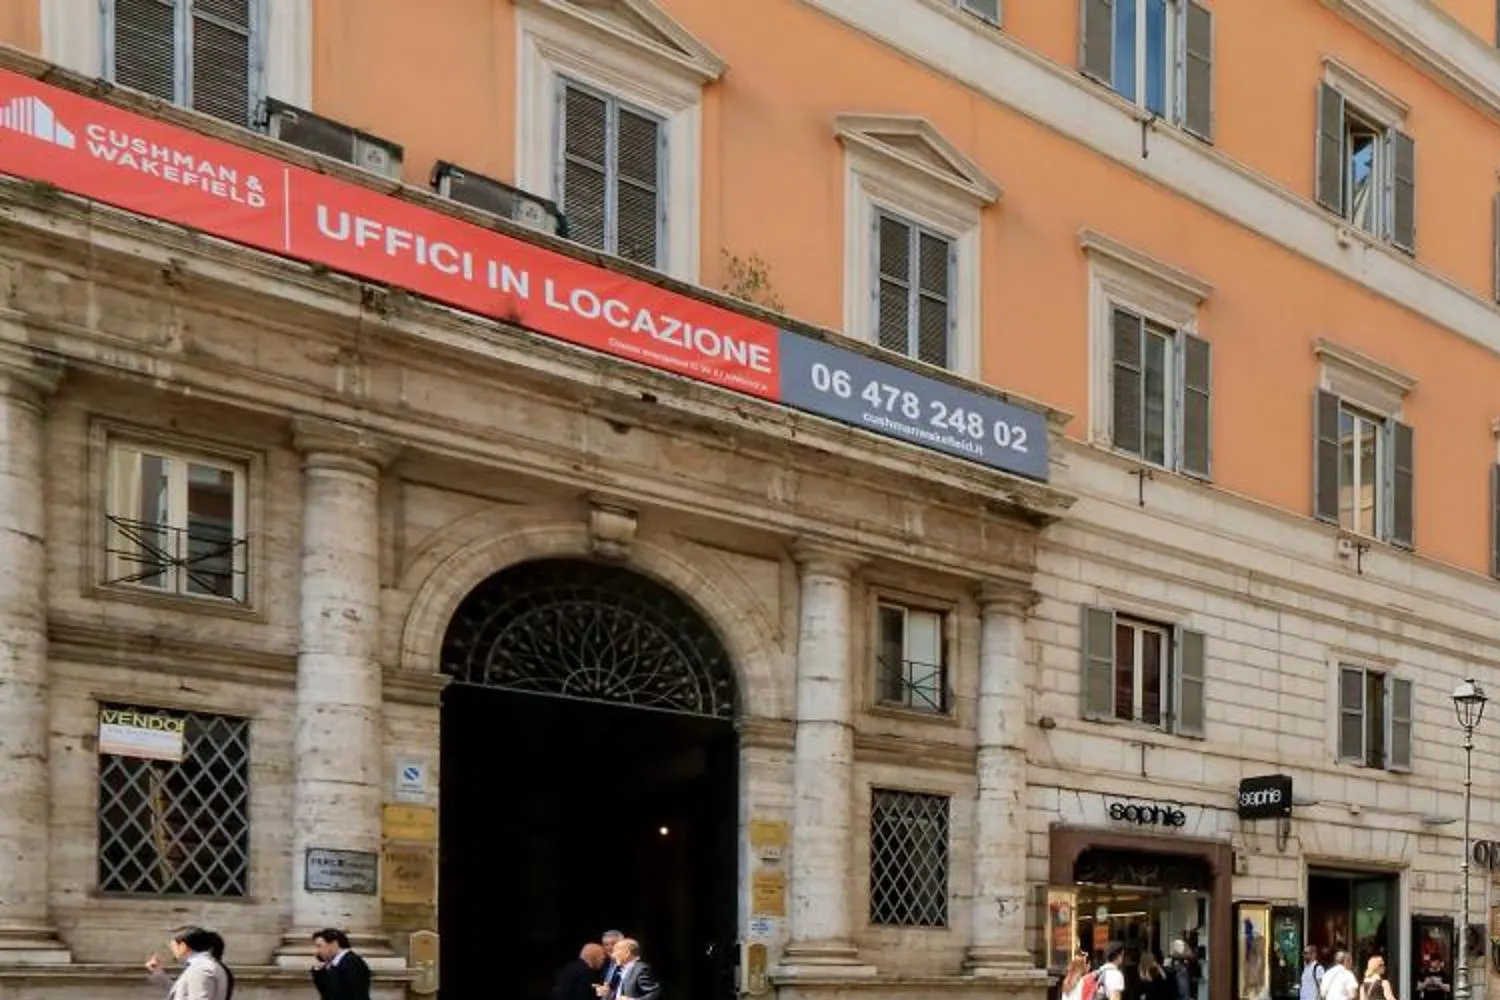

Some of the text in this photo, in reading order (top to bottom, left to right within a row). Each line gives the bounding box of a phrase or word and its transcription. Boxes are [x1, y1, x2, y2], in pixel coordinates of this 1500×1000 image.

[86, 123, 263, 193] CUSHMAN &
[87, 139, 266, 208] WAKEFIELD
[317, 205, 473, 281] UFFICI
[488, 260, 529, 299] IN
[544, 278, 772, 373] LOCAZIONE
[811, 363, 852, 399] 06
[861, 381, 920, 420] 478
[929, 401, 984, 440] 248
[993, 421, 1028, 453] 02
[863, 412, 984, 457] cushmanwakefield.it
[1110, 803, 1186, 827] sophie
